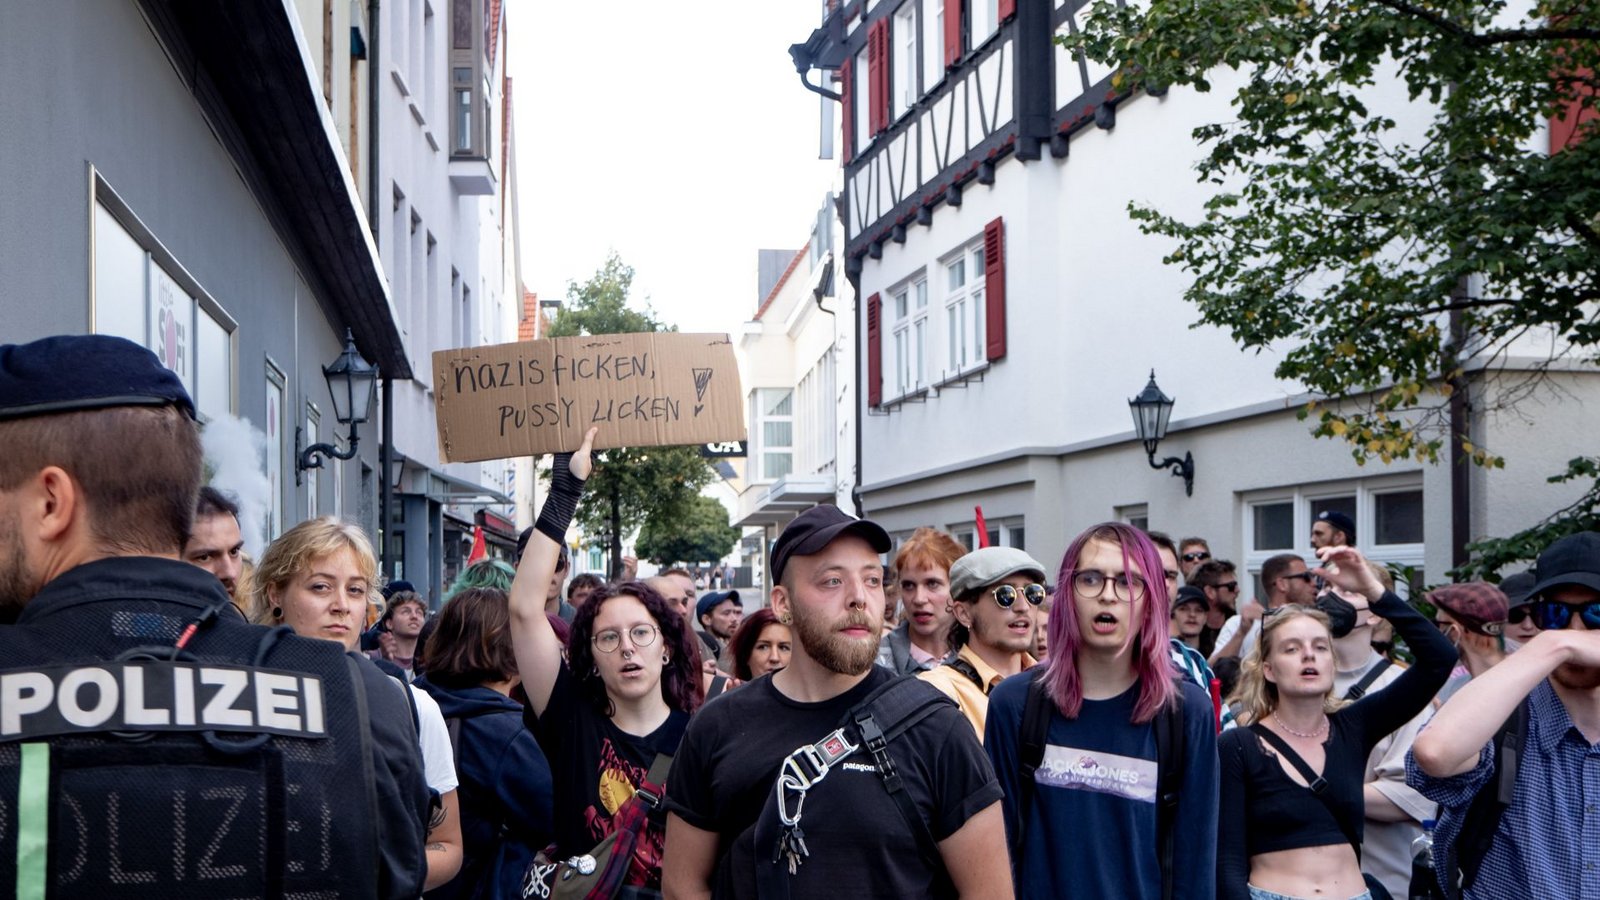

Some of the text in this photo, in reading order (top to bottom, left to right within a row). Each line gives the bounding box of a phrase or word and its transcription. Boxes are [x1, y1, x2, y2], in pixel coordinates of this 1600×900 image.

[455, 355, 545, 393] nazis
[499, 397, 574, 436] PUSSY
[592, 395, 679, 422] LICKEN
[0, 665, 325, 736] POLIZEI
[843, 763, 876, 772] patagon
